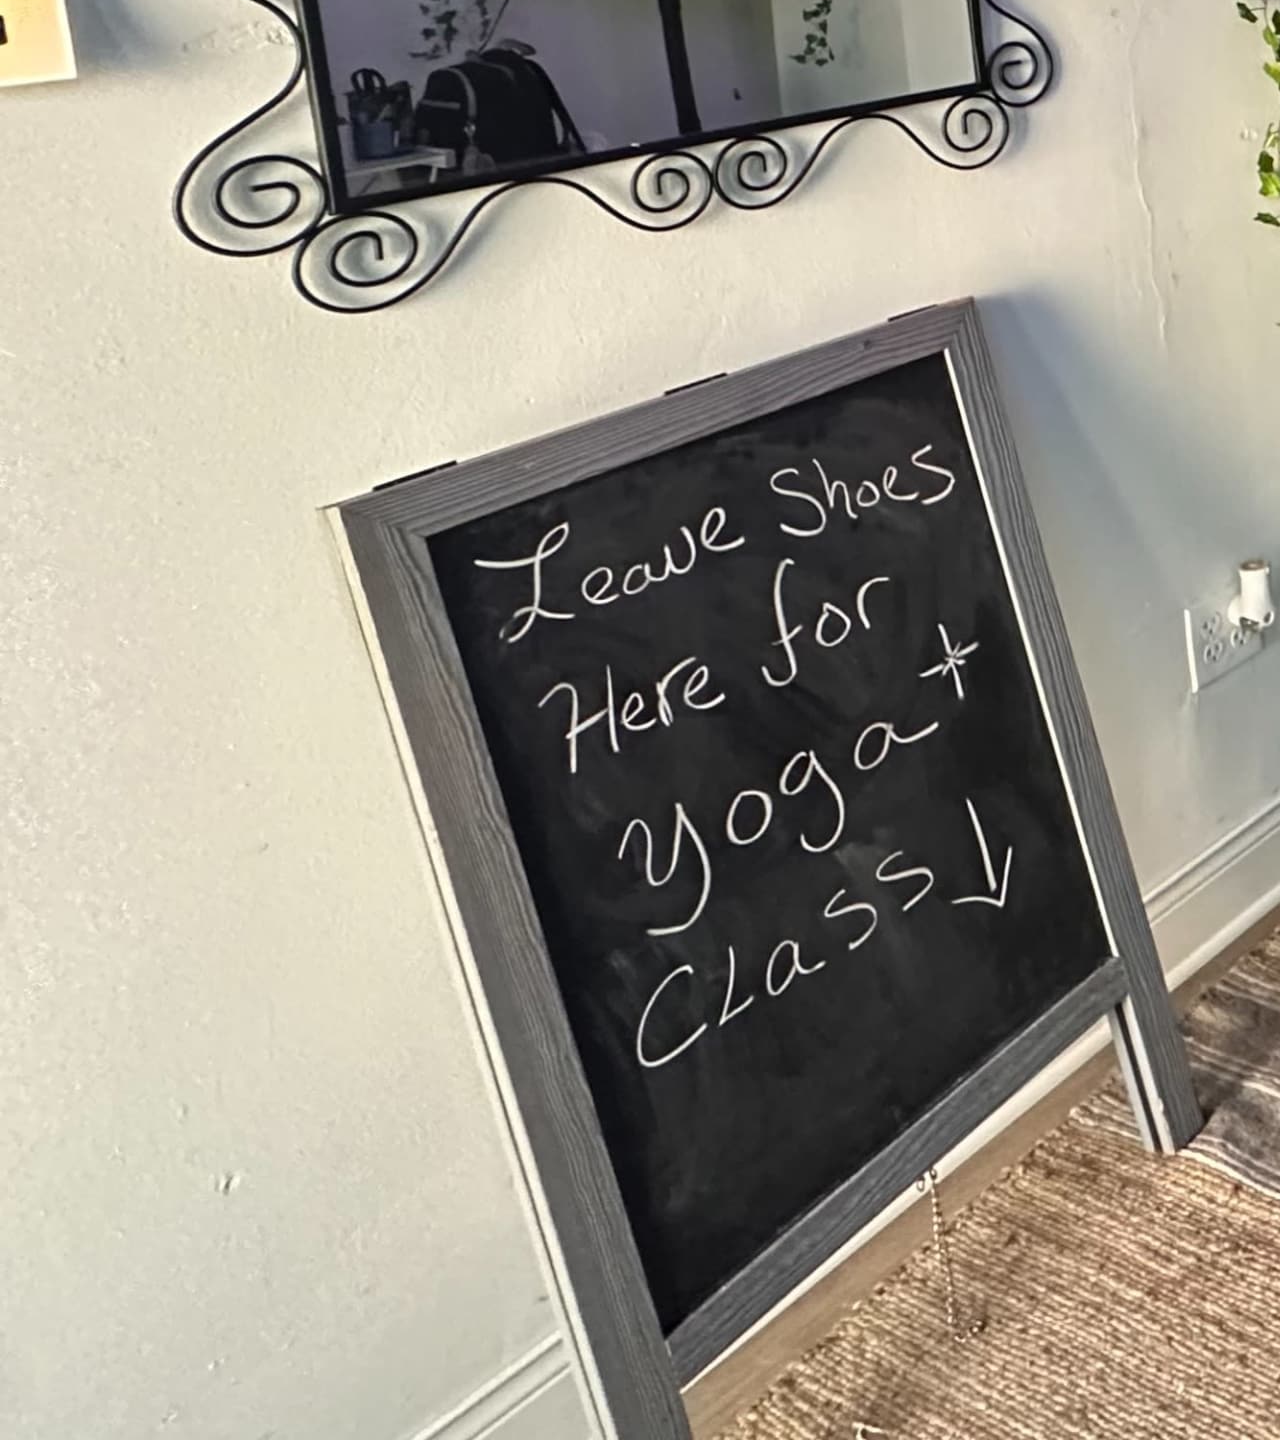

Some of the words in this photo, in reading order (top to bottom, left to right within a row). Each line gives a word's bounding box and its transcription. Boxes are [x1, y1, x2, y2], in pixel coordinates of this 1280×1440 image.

[474, 506, 746, 644] Leave
[768, 444, 957, 538] Shoes
[538, 655, 727, 774] Here
[761, 557, 890, 687] for
